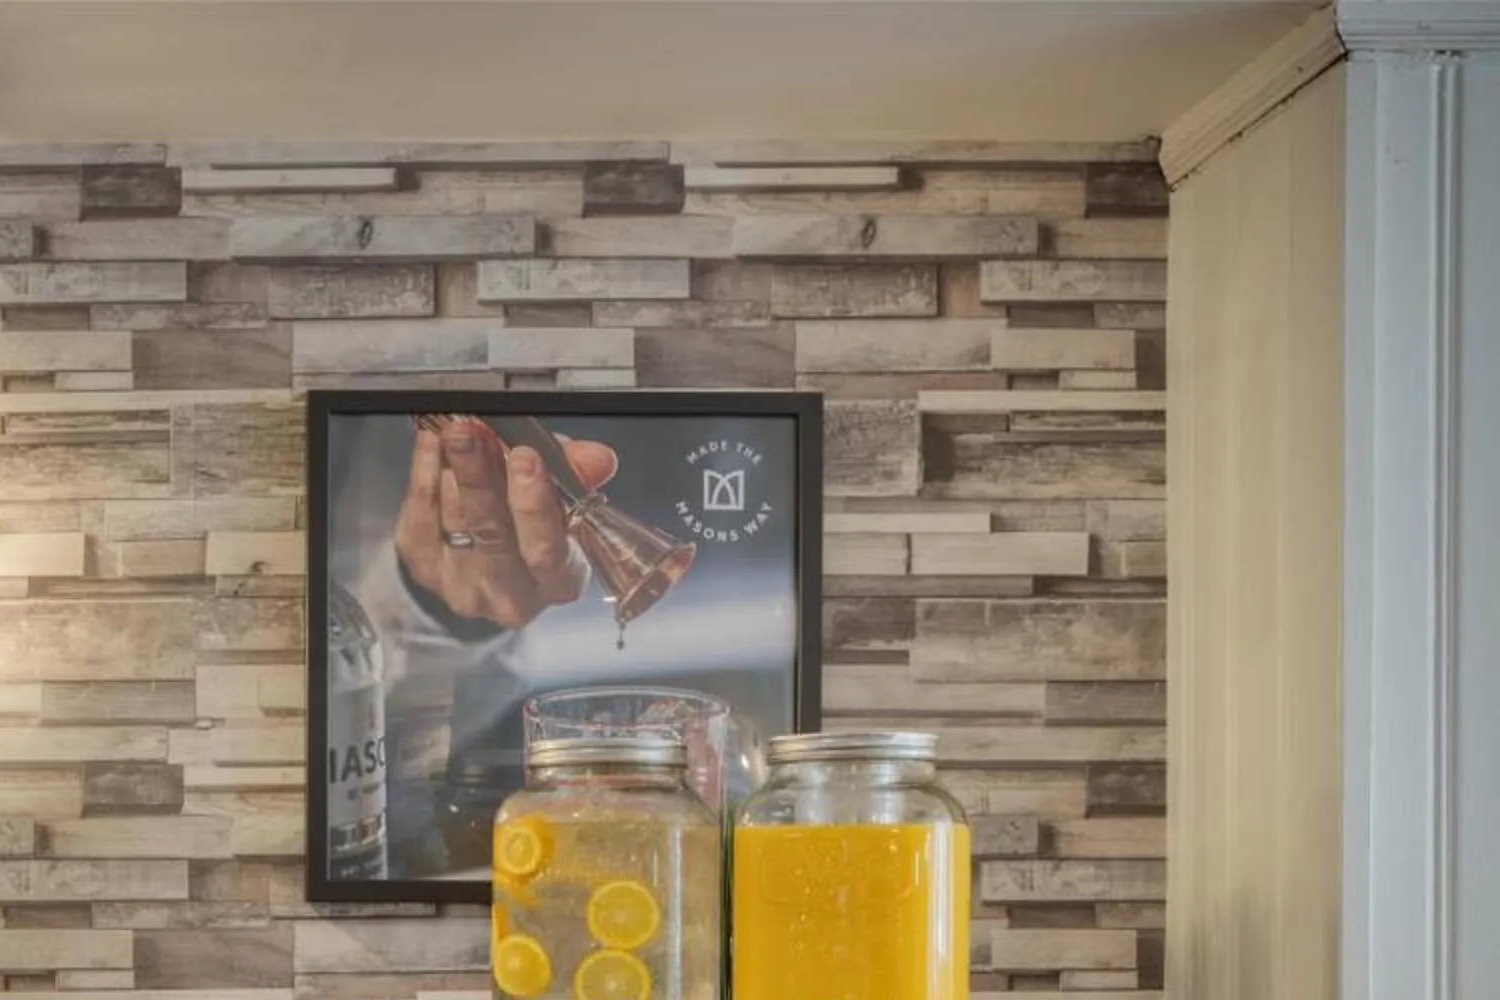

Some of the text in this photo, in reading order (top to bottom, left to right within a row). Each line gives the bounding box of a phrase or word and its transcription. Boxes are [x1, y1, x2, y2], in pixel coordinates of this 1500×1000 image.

[686, 440, 762, 465] MADE THE
[675, 501, 772, 542] MASONS WAY
